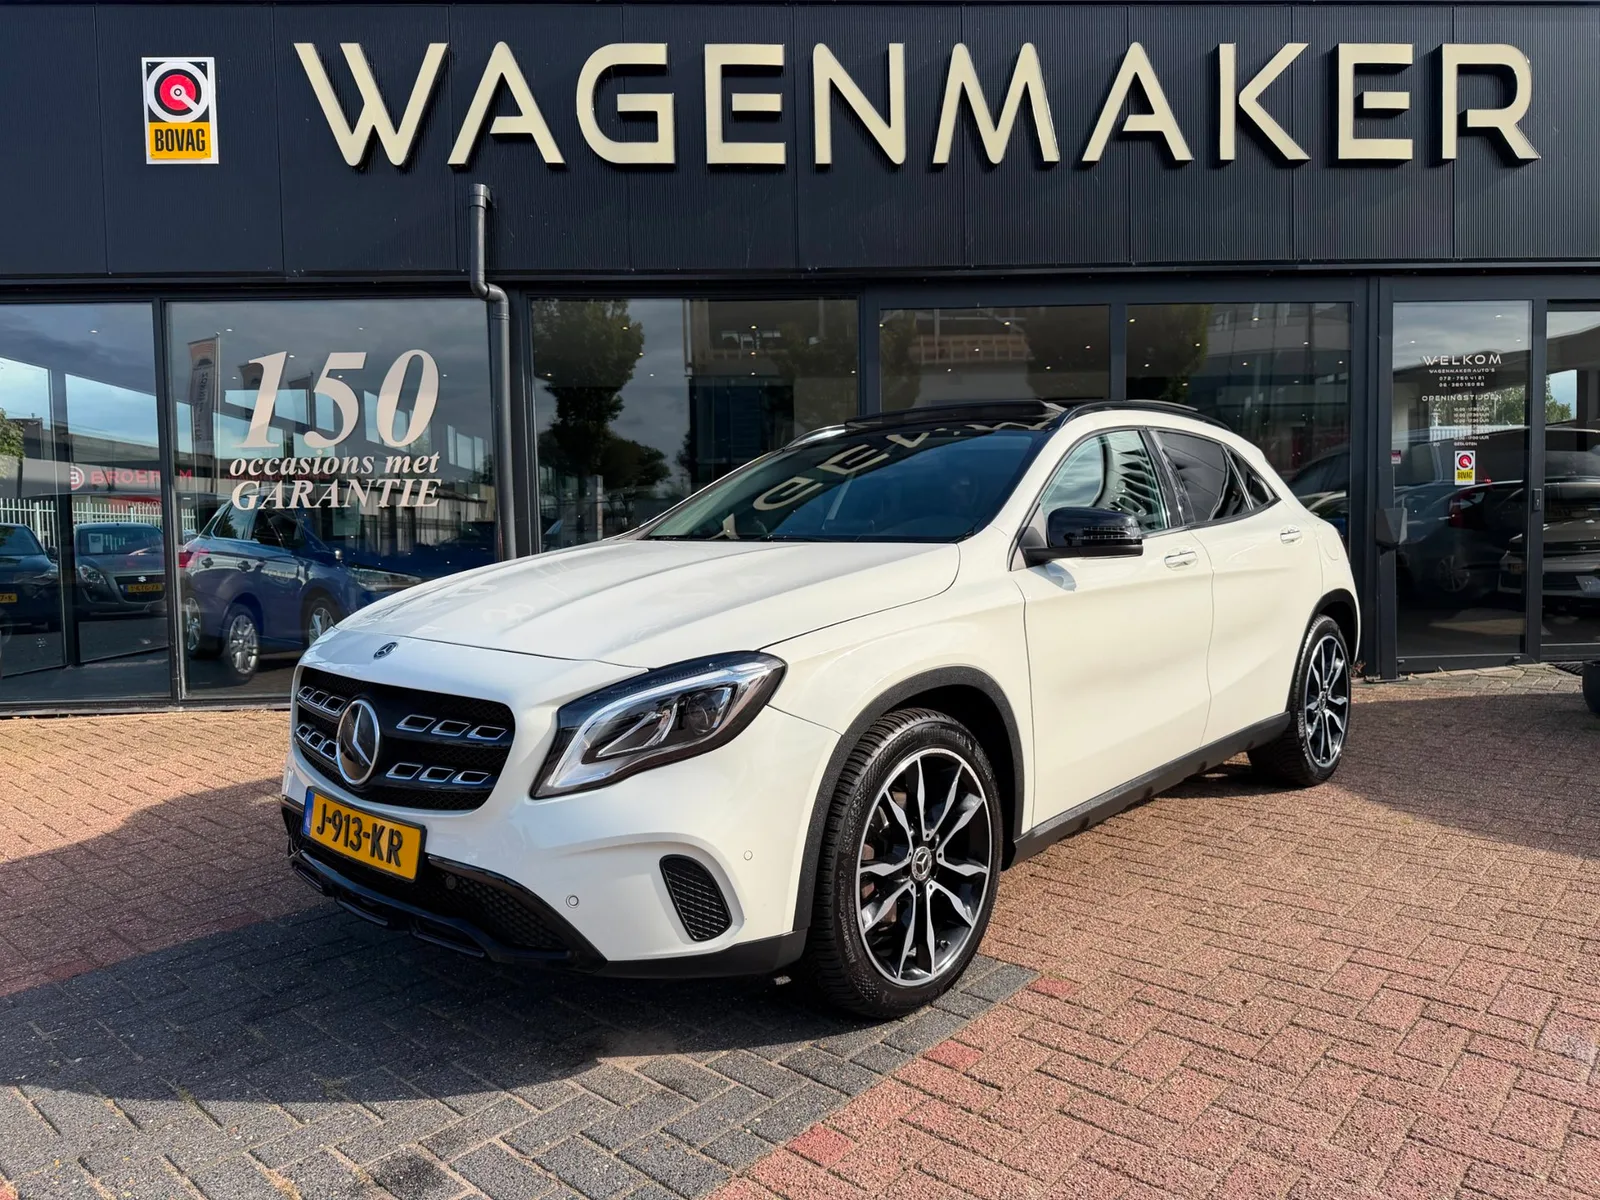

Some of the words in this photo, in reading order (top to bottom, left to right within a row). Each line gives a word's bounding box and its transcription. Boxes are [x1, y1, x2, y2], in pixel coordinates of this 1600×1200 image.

[293, 41, 1541, 166] WAGENMAKER
[154, 128, 207, 154] BOVAG
[1422, 354, 1502, 366] WELKOM
[231, 349, 439, 448] 150
[1421, 393, 1502, 402] OPENINGSTIJDEN
[229, 449, 375, 477] occasions
[384, 451, 441, 474] met
[231, 478, 442, 511] GARANTIE
[316, 803, 403, 867] J-913-KR
